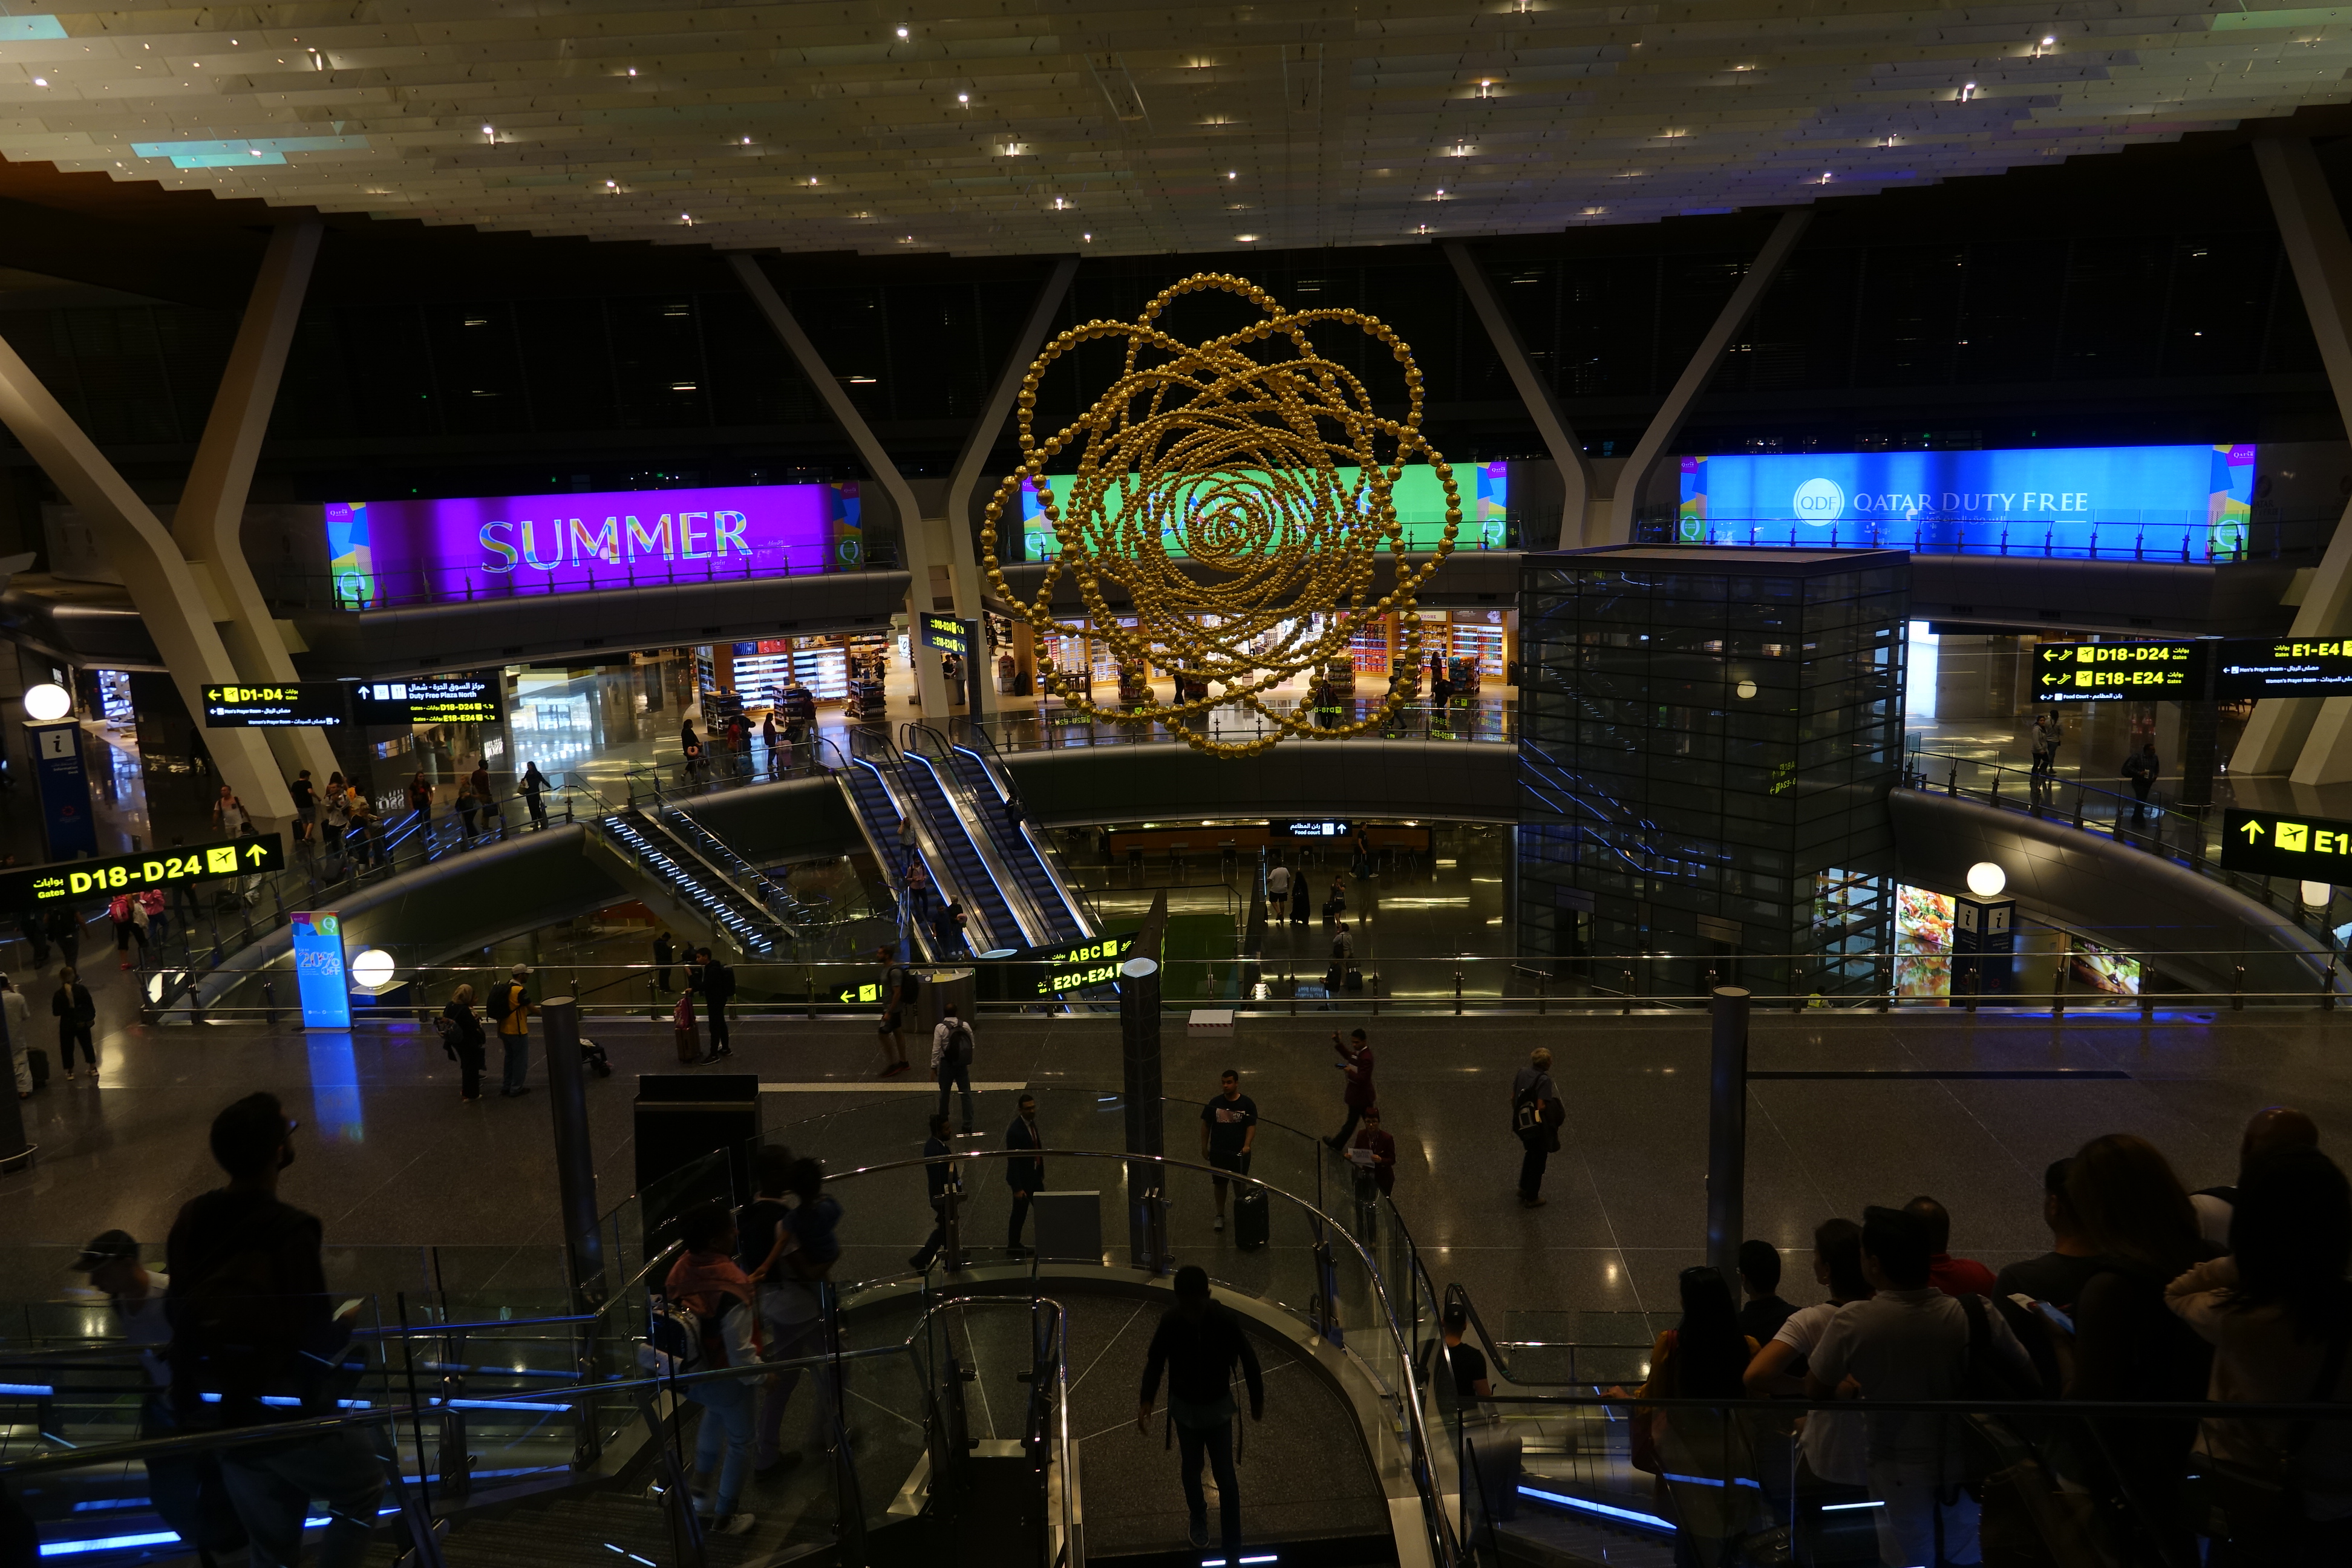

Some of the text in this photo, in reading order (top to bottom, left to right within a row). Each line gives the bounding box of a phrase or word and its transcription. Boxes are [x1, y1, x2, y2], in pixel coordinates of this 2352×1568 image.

[1800, 495, 1837, 511] QDF
[1854, 492, 2088, 513] QATAR DUTY FREE
[479, 510, 753, 573] SUMMER
[2096, 647, 2169, 661] D18-D24
[2292, 643, 2339, 657] E1-E4
[2095, 671, 2164, 685] E18-E24
[408, 683, 428, 692] شمال
[433, 683, 448, 691] الحرة
[448, 683, 471, 691] السوق
[240, 688, 284, 701] D1-D4
[2314, 830, 2352, 855] E1
[70, 854, 202, 894] D18-D24
[33, 877, 64, 889] بوابات
[38, 888, 65, 899] Gates
[299, 951, 341, 968] 20%
[1069, 946, 1101, 962] ABC
[321, 966, 341, 976] OFF
[1054, 966, 1114, 991] E20-E24
